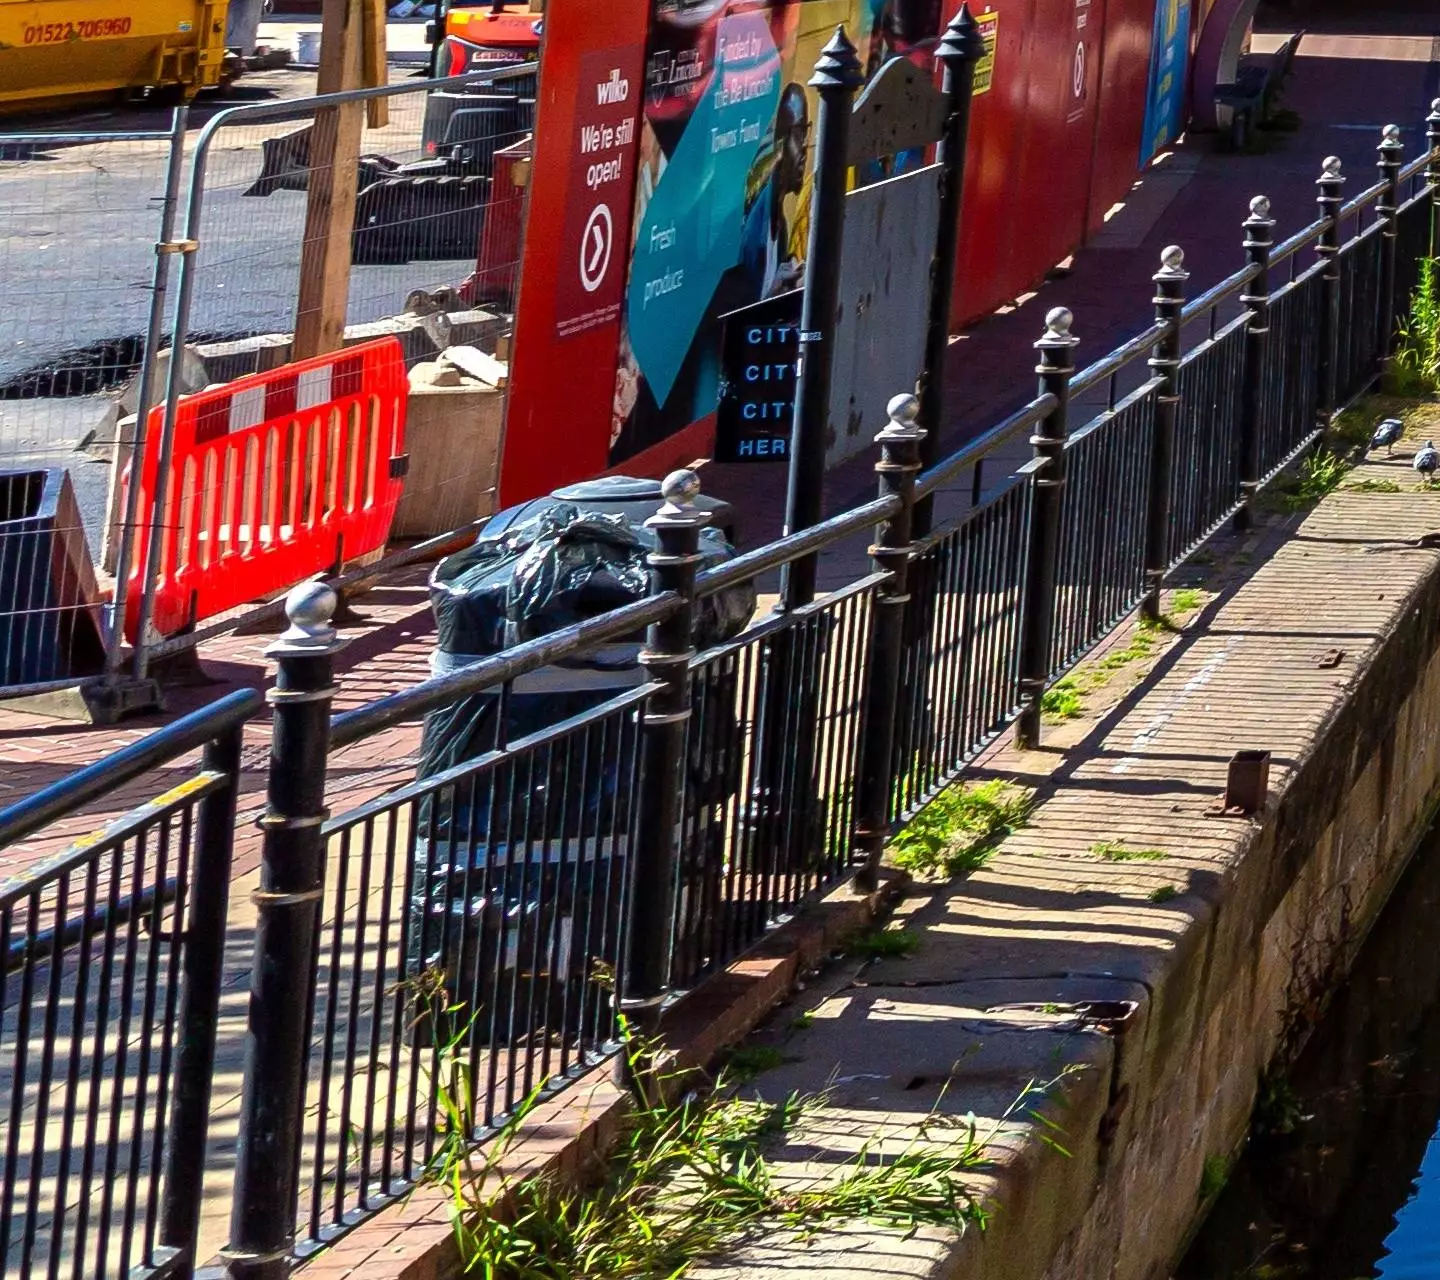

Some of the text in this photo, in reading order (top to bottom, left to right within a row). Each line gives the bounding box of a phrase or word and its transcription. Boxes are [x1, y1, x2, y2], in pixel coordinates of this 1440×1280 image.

[24, 17, 132, 44] 01522 706960
[597, 68, 629, 105] wilko
[581, 117, 635, 154] We're still
[587, 153, 622, 190] open!
[649, 221, 676, 254] Fresh
[643, 267, 684, 311] produce
[745, 365, 797, 381] CIT
[743, 402, 795, 419] CIT
[739, 438, 790, 455] HER
